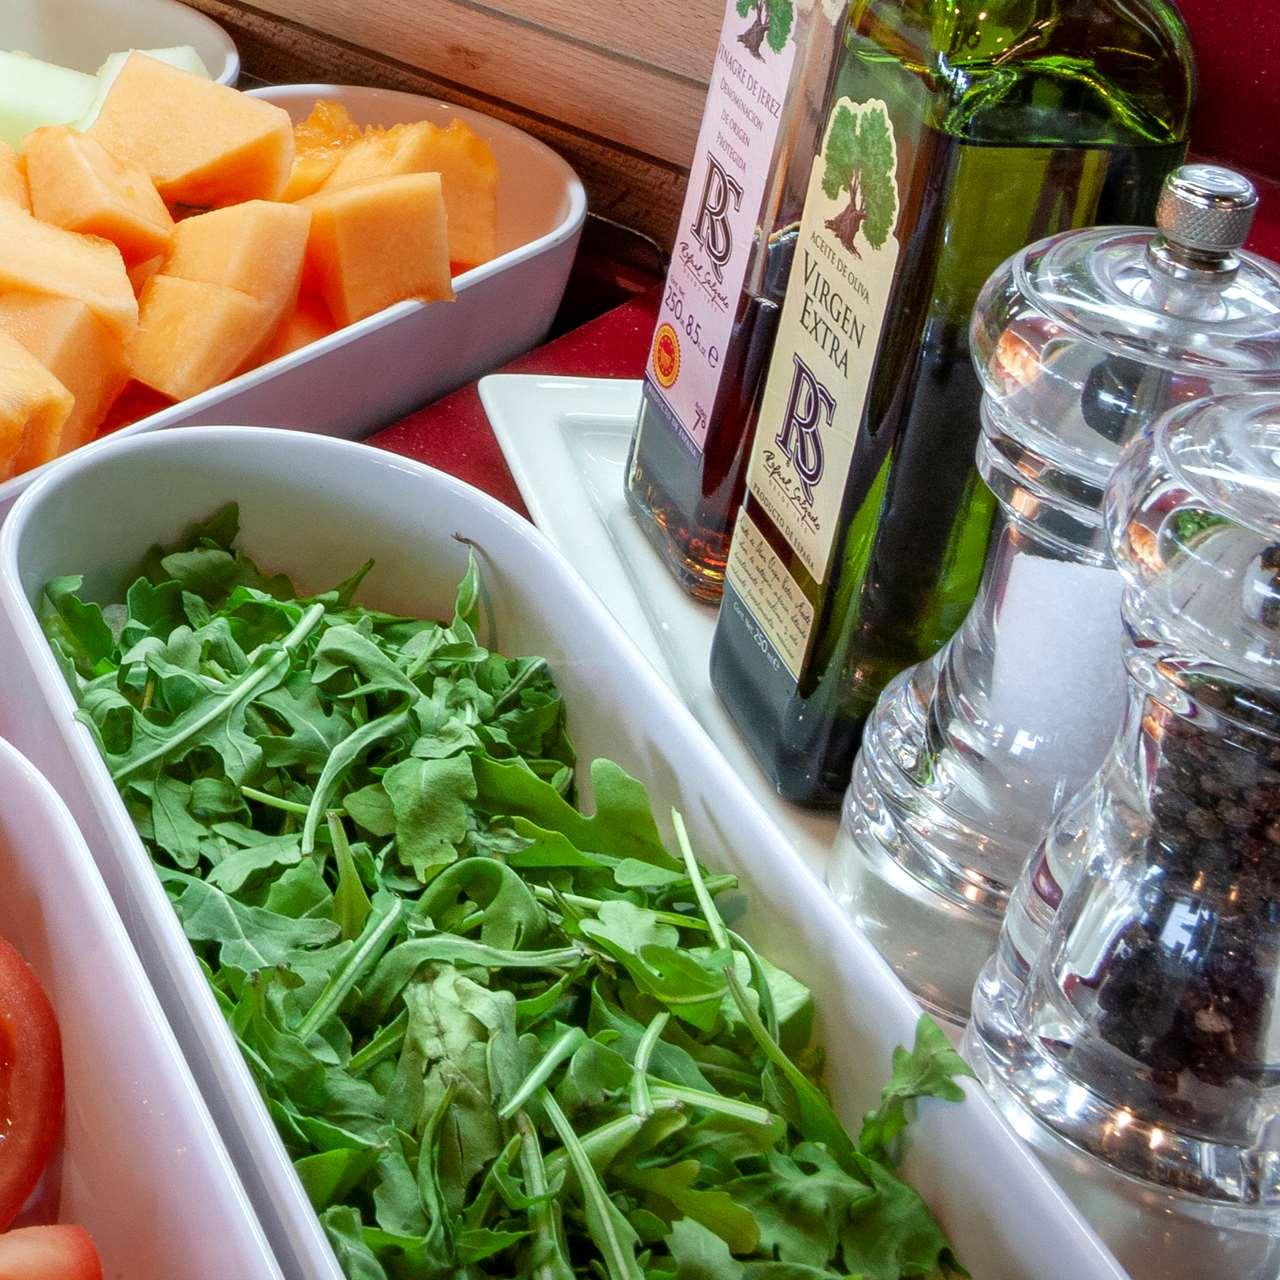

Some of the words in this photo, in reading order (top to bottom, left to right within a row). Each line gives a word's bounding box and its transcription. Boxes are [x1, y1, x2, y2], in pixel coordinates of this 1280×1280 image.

[746, 74, 758, 96] DE
[757, 86, 782, 119] JEREZ
[729, 116, 751, 148] ORIGEN
[810, 231, 836, 266] ACEITE
[836, 258, 848, 278] DE
[847, 272, 870, 305] OLIVA
[665, 286, 684, 321] 250
[803, 247, 866, 349] VIRGEN
[799, 291, 849, 379] EXTRA
[752, 481, 785, 532] PRODUCTO
[784, 525, 794, 543] DE
[753, 628, 768, 654] 250
